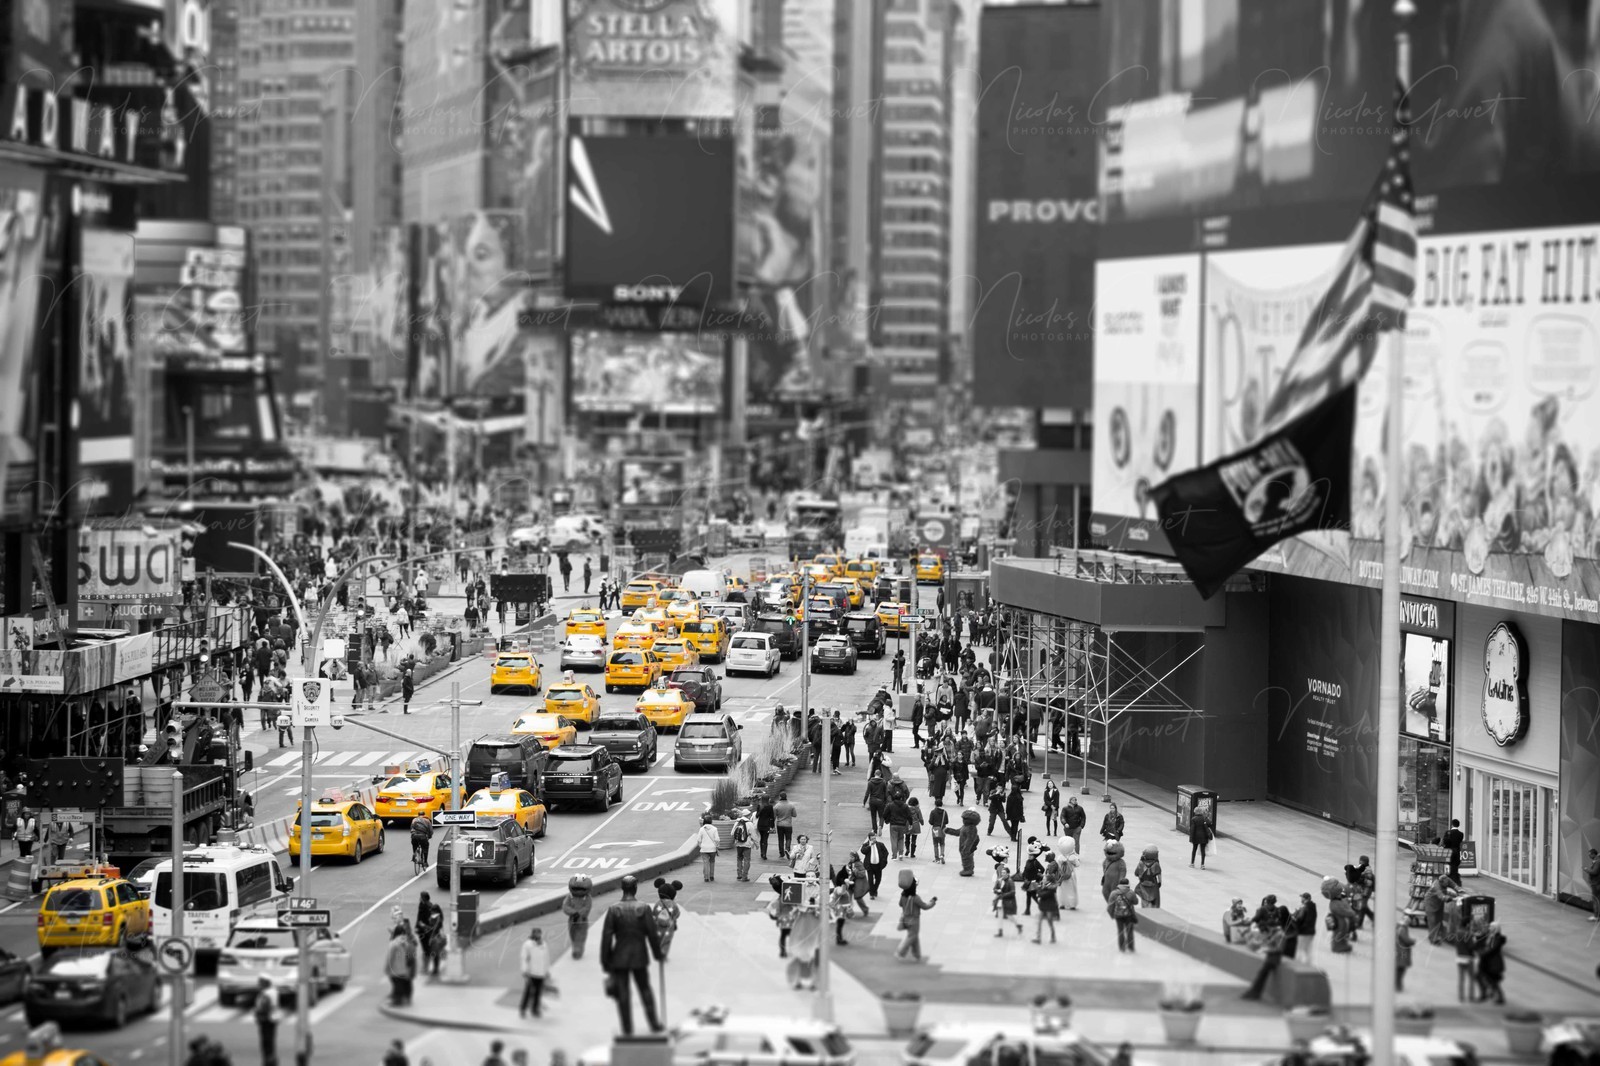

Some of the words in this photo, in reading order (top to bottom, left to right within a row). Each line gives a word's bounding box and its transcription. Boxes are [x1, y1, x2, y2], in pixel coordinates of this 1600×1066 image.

[586, 15, 698, 36] STELLA
[585, 39, 700, 64] ARTOIS
[1424, 245, 1469, 307] BIG
[1480, 242, 1532, 306] FAT
[1541, 237, 1600, 305] HIT
[613, 284, 683, 301] SONY
[1467, 575, 1491, 598] JAMES
[1492, 578, 1525, 604] THEATRE,
[1573, 591, 1598, 613] between
[1307, 678, 1342, 698] VORNADO
[292, 899, 299, 908] W
